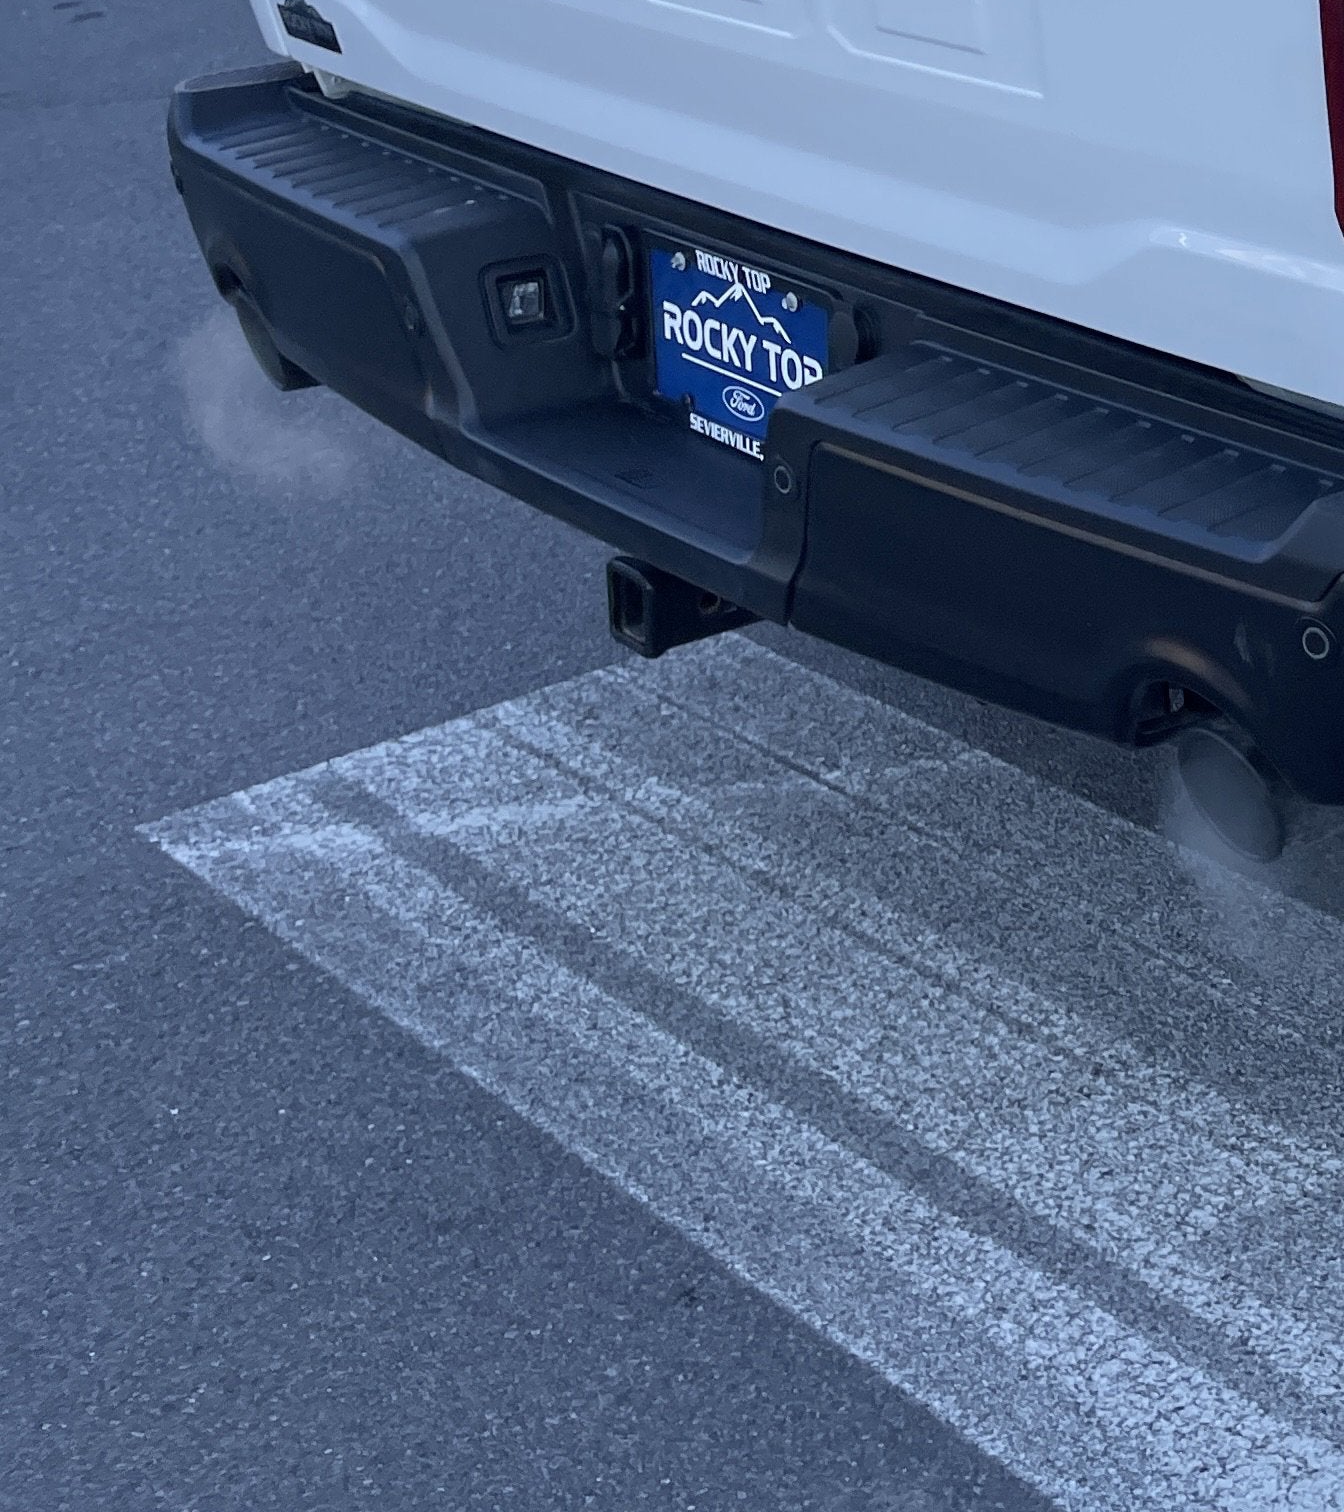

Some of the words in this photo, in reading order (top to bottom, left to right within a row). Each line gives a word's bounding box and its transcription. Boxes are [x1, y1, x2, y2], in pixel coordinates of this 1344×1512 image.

[695, 249, 739, 284] ROCKY
[742, 266, 771, 294] TOP
[663, 300, 757, 372] ROCKY
[729, 389, 757, 417] Ford
[690, 412, 764, 461] SEVIERVILLE,
